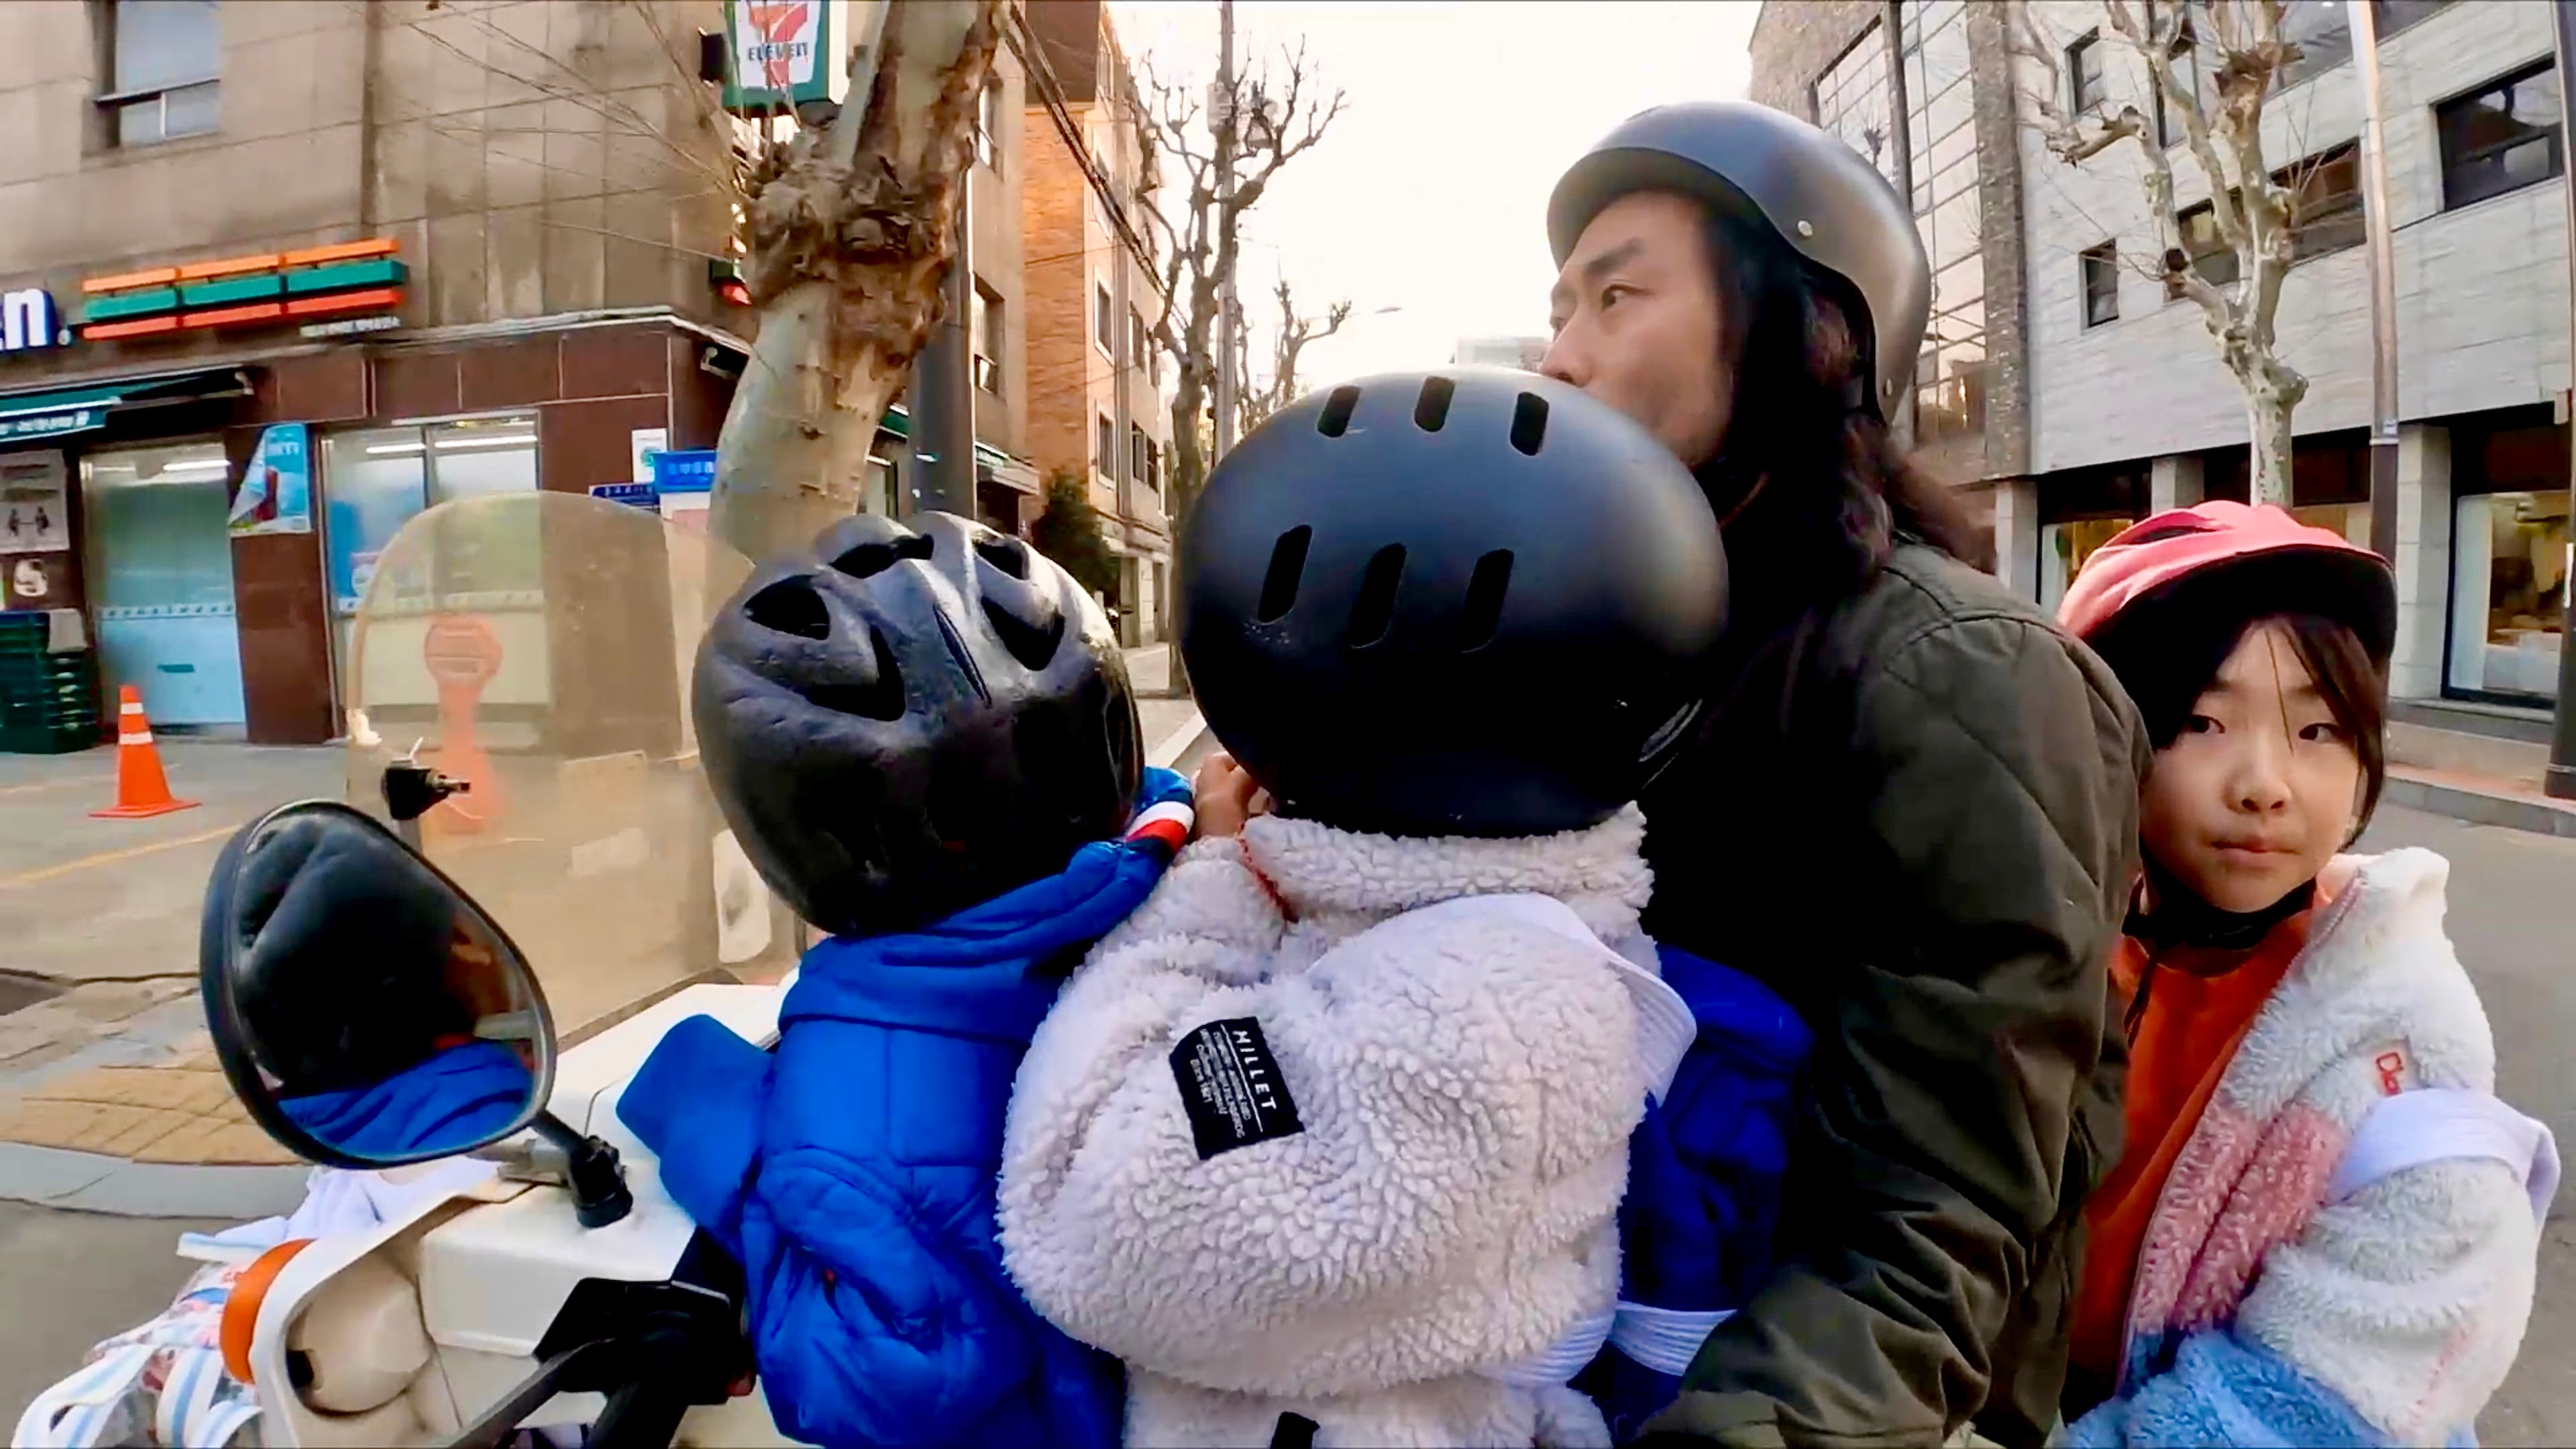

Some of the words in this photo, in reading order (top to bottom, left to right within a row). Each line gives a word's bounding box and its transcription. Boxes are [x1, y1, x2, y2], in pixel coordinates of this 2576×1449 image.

[748, 42, 808, 62] ELEVEN
[749, 4, 808, 86] 7
[1232, 1030, 1277, 1110] MILLET
